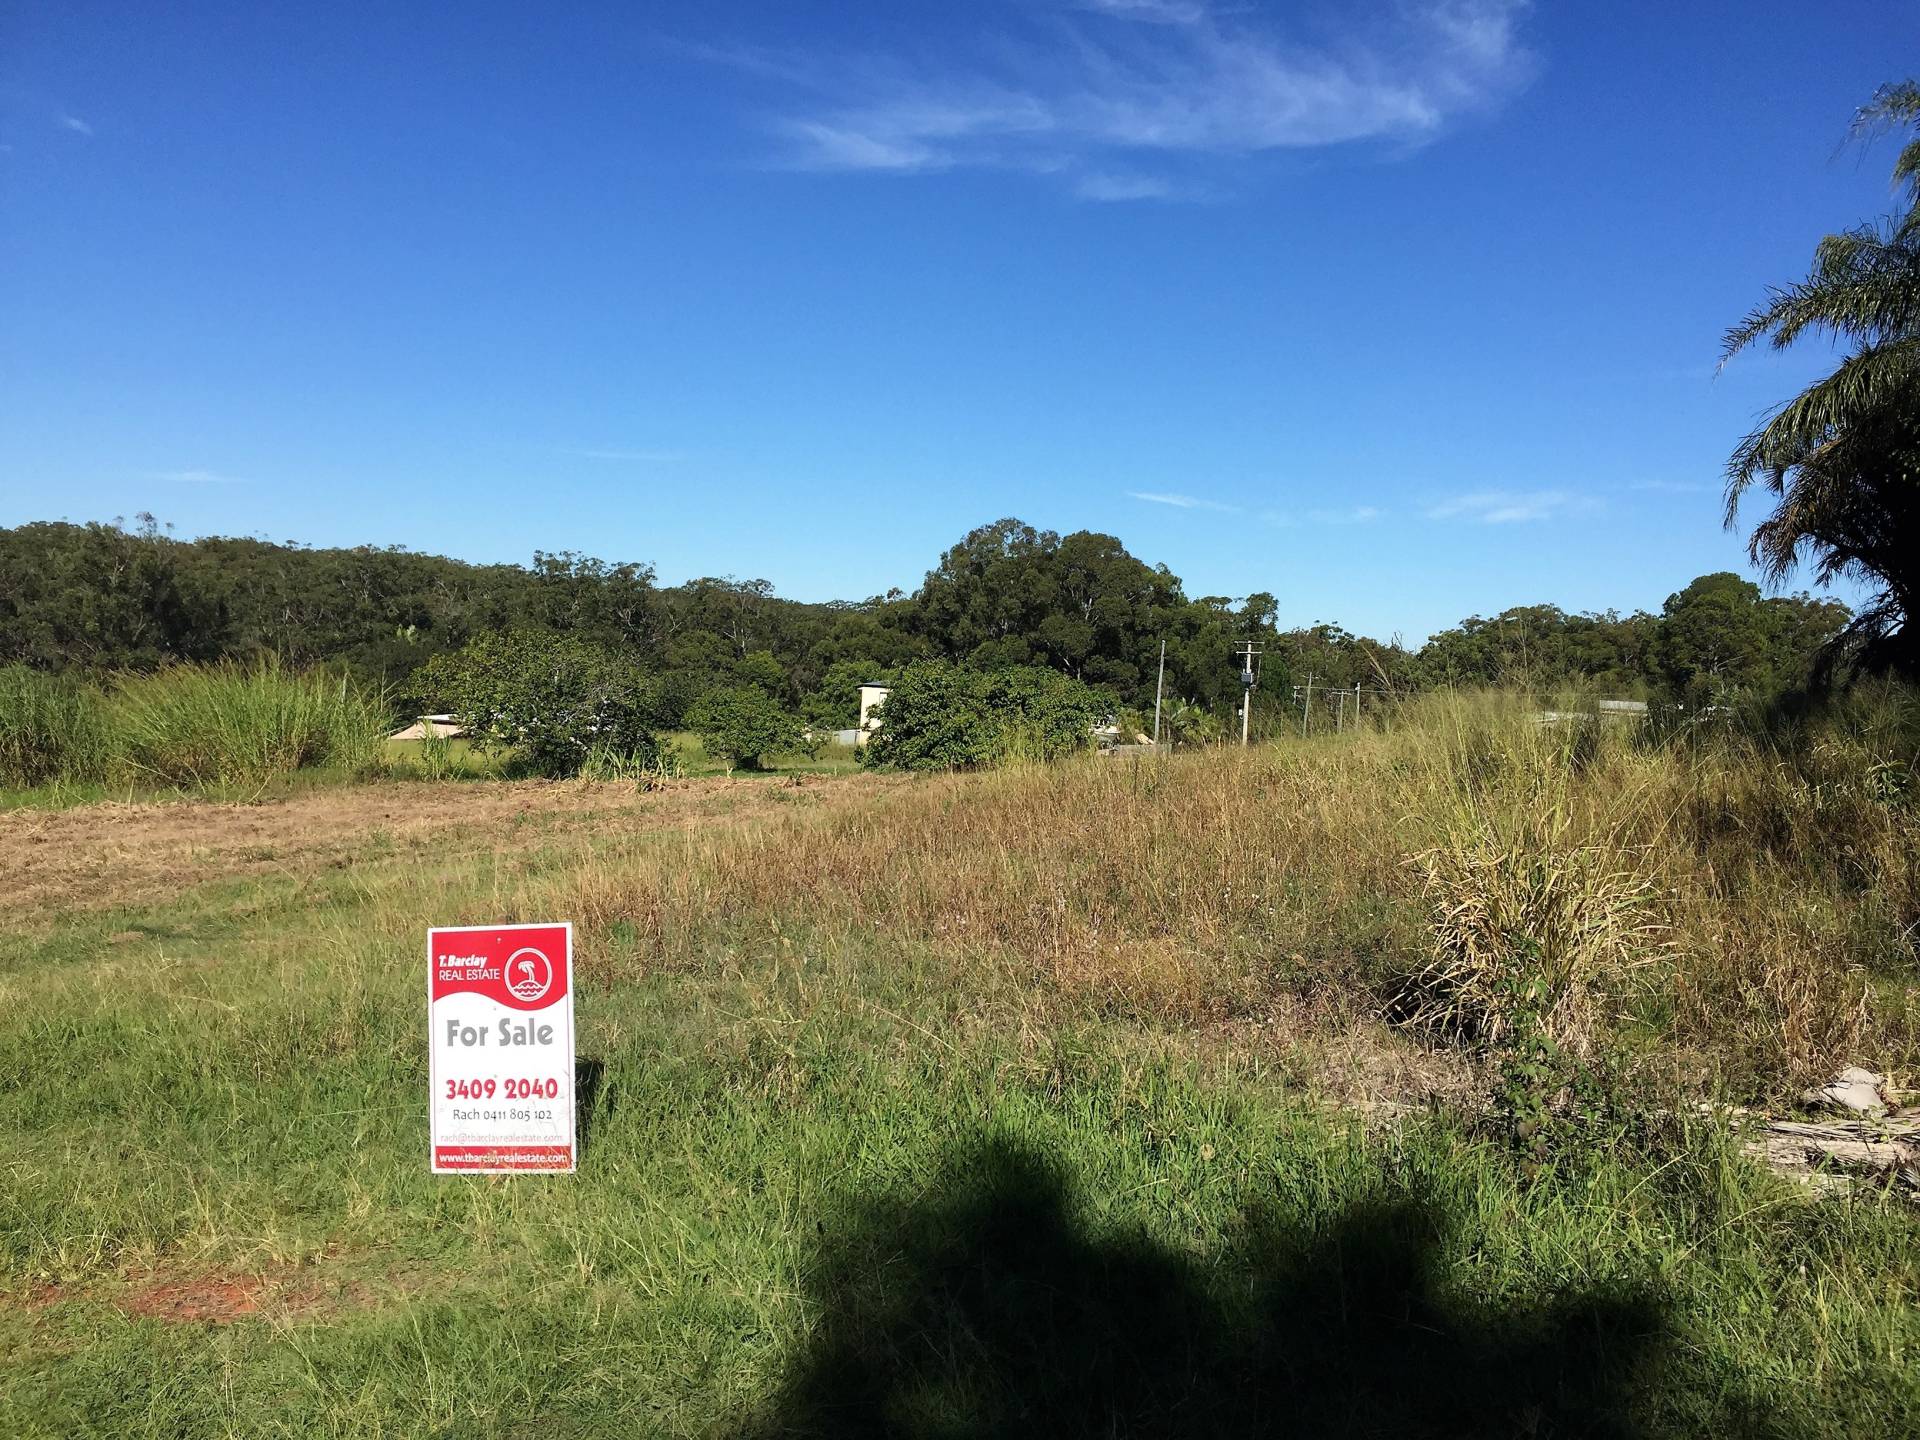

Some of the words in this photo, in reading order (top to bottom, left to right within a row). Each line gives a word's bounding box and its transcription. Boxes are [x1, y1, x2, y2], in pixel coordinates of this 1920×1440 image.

[439, 969, 464, 981] REAL
[467, 968, 500, 980] ESTATE
[447, 1019, 488, 1047] For
[498, 1018, 554, 1046] Sale
[446, 1079, 496, 1100] 3409
[504, 1078, 558, 1099] 2040
[453, 1108, 480, 1120] Rach
[483, 1109, 506, 1121] 0411
[510, 1108, 530, 1121] 805
[535, 1109, 552, 1120] 102
[439, 1152, 568, 1165] www.tbarclayrealestate.com
